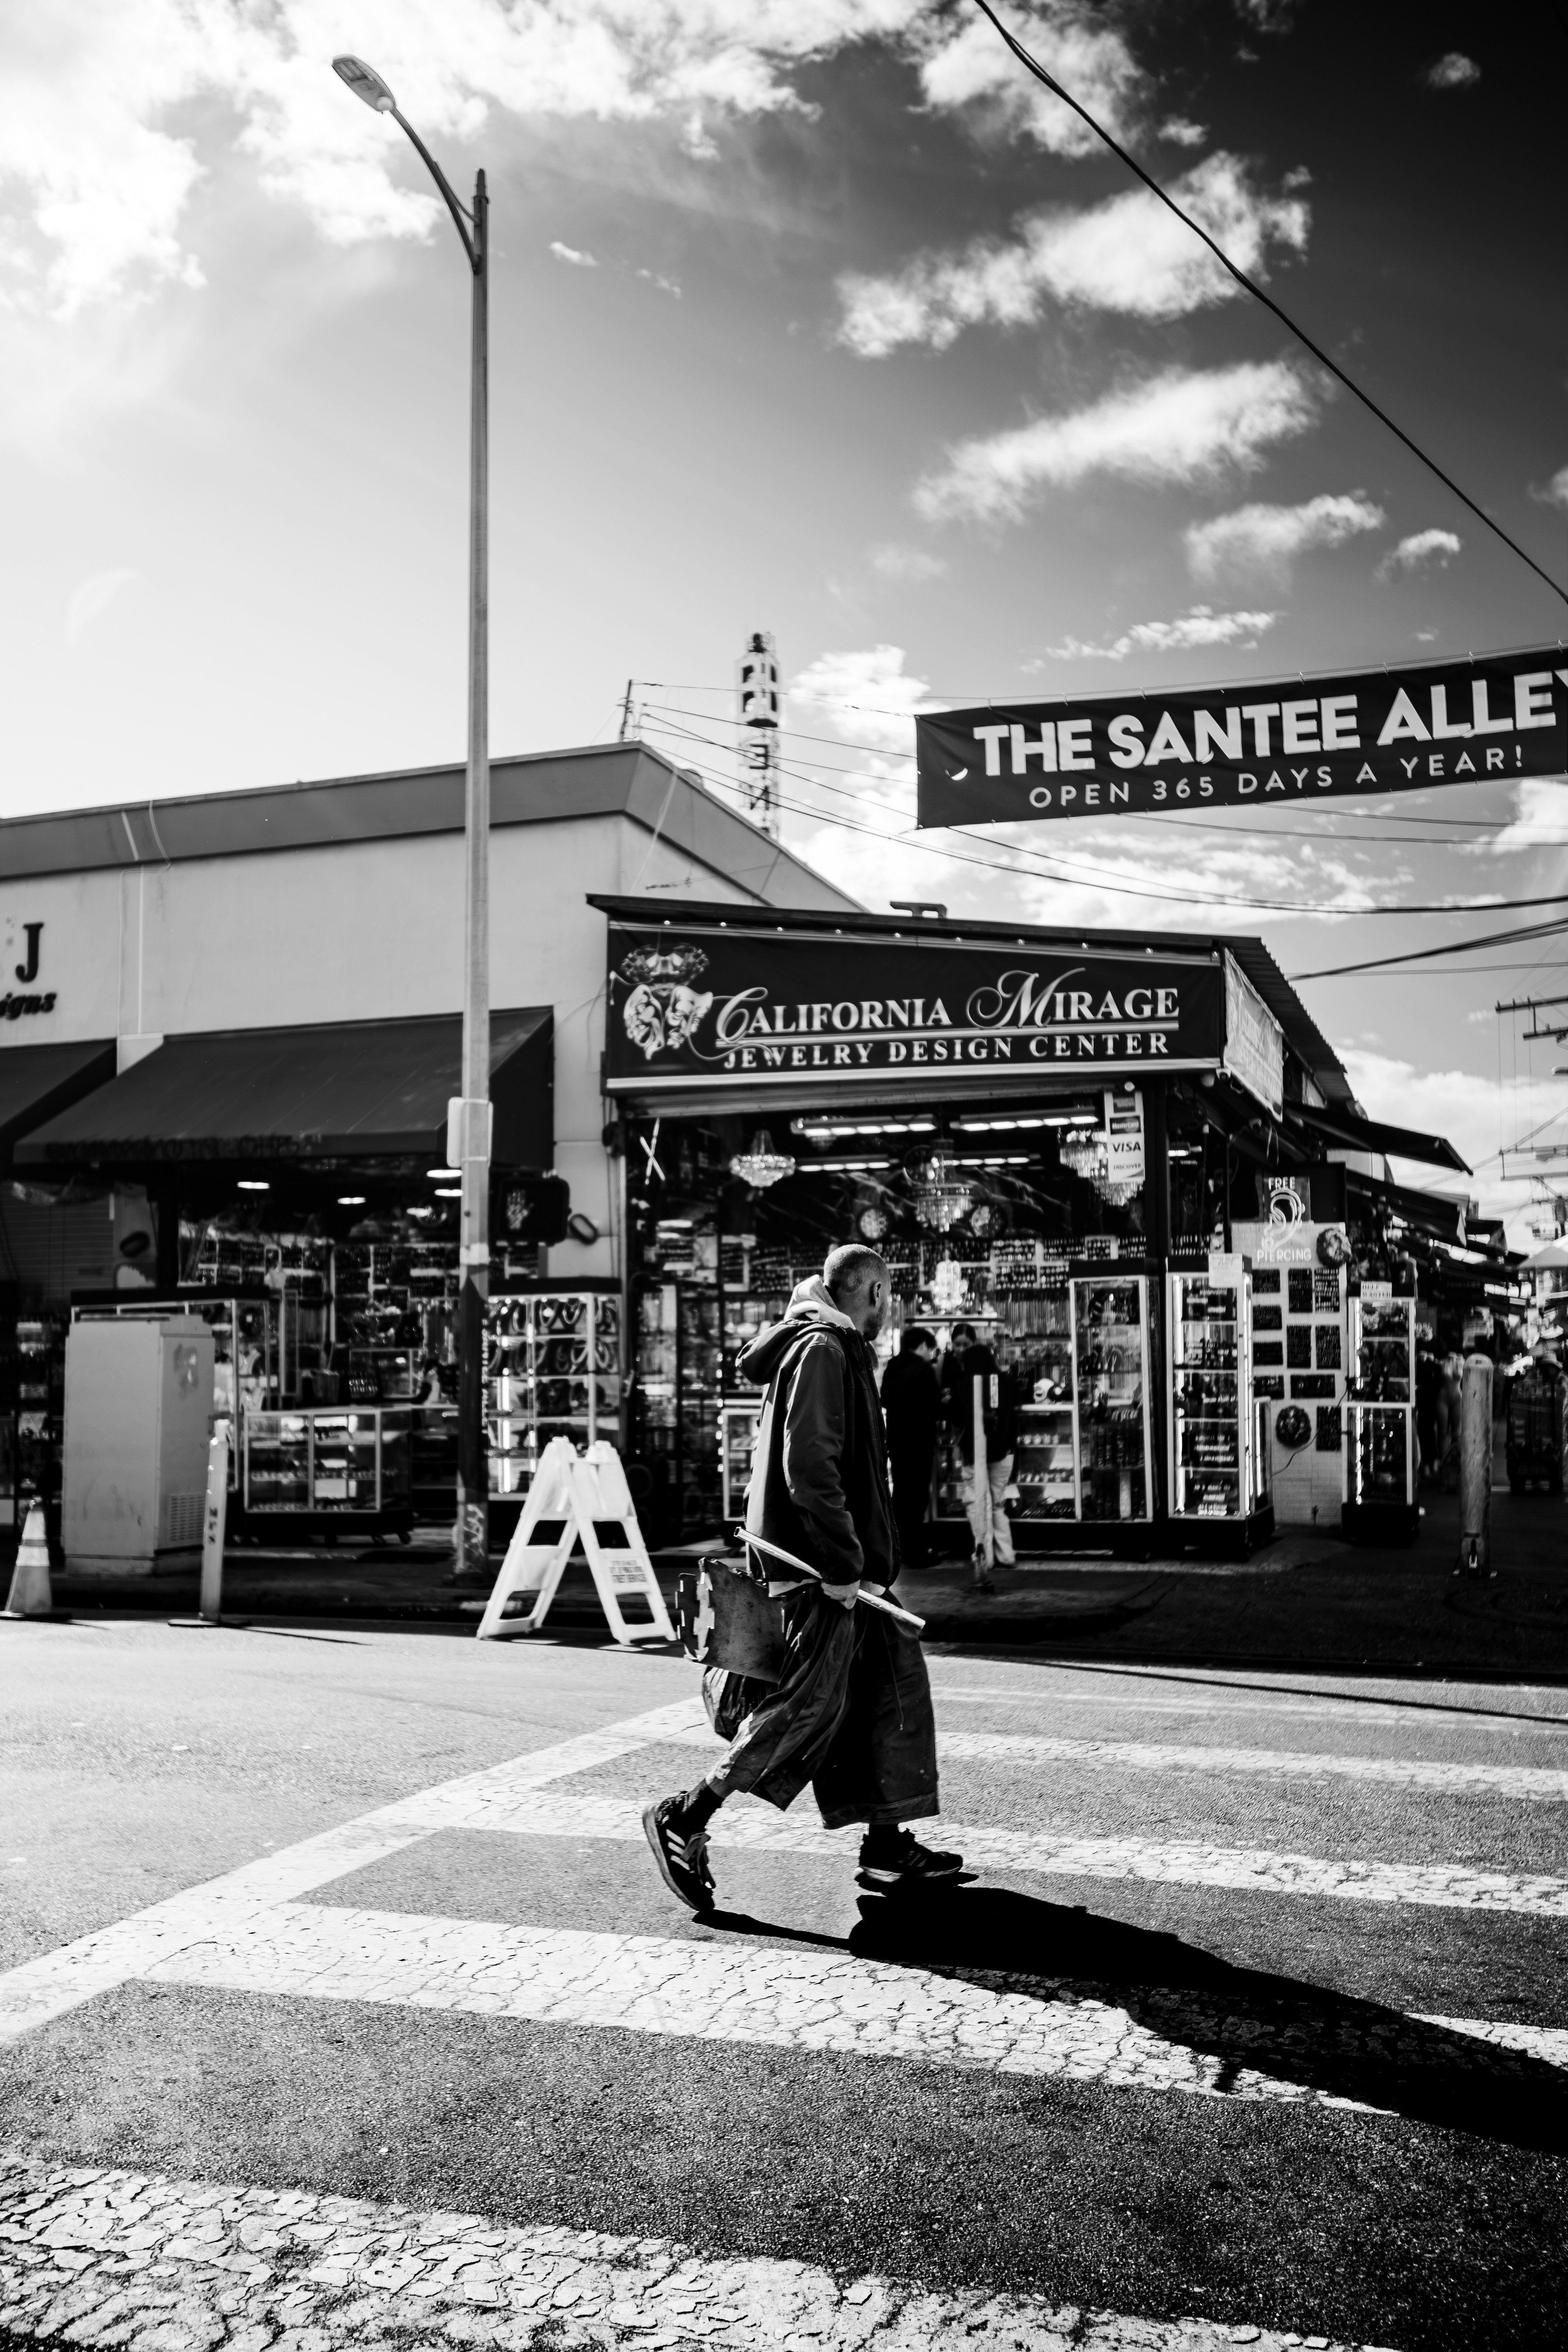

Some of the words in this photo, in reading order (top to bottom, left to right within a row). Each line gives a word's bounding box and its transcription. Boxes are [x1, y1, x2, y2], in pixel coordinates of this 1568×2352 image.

[973, 719, 1096, 776] THE
[1107, 694, 1361, 769] SANTEE
[1029, 782, 1130, 808] OPEN
[1152, 776, 1214, 800] 365
[1238, 766, 1332, 794] DAYS
[1356, 761, 1377, 784] A
[1400, 744, 1522, 778] YEAR!
[716, 987, 953, 1043] CALIFORNIA
[965, 967, 1179, 1029] MIRAGE
[724, 1043, 874, 1069] JEWELRY
[888, 1038, 1012, 1062] DESIGN
[1029, 1033, 1169, 1057] CENTER
[1113, 1142, 1142, 1153] VISA
[1268, 1176, 1295, 1190] FREE
[1257, 1248, 1312, 1263] PIERCING
